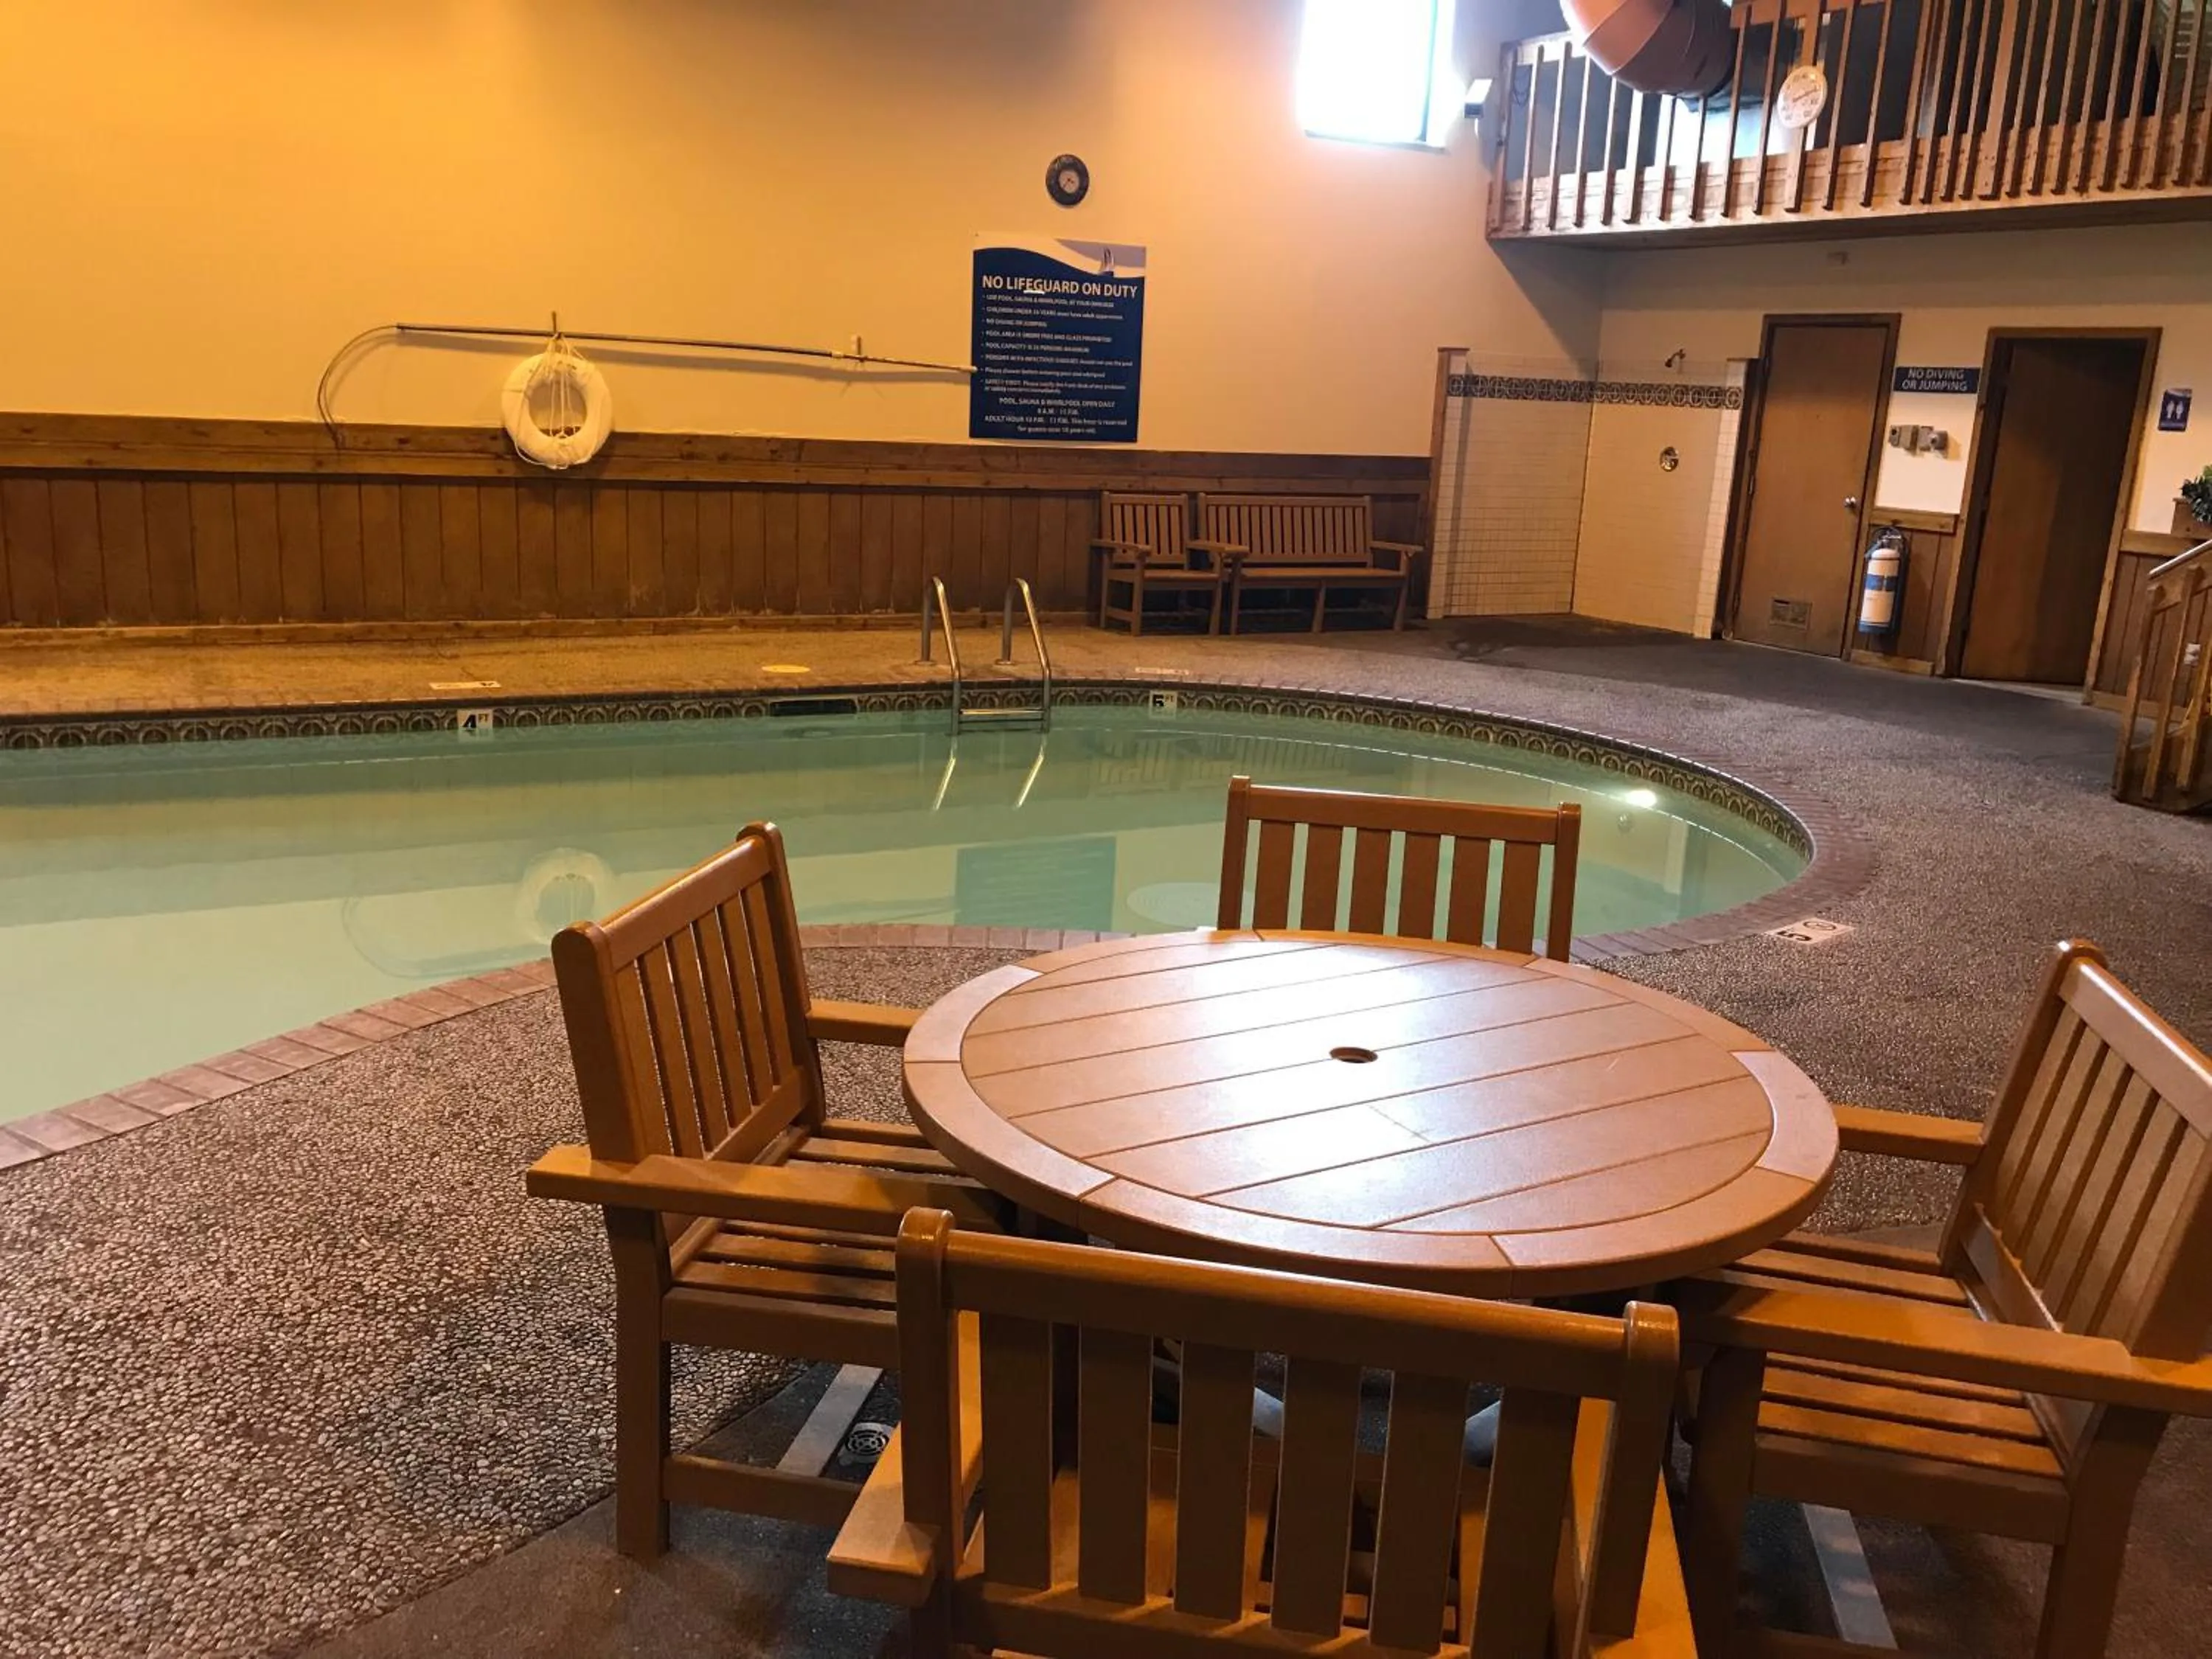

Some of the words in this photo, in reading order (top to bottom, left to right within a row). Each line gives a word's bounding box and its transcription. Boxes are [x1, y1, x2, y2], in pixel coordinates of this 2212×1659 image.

[982, 275, 1004, 288] NO
[1006, 276, 1079, 294] LIFEGUARD
[1082, 282, 1101, 296] ON
[1104, 284, 1138, 299] DUTY
[1907, 369, 1924, 379] NO
[1926, 369, 1965, 380] DIVING
[1902, 380, 1916, 390] OR
[1919, 380, 1968, 392] JUMPING
[1152, 694, 1164, 707] 5
[462, 714, 477, 728] 4
[478, 713, 488, 723] FT
[1775, 930, 1812, 942] 5
